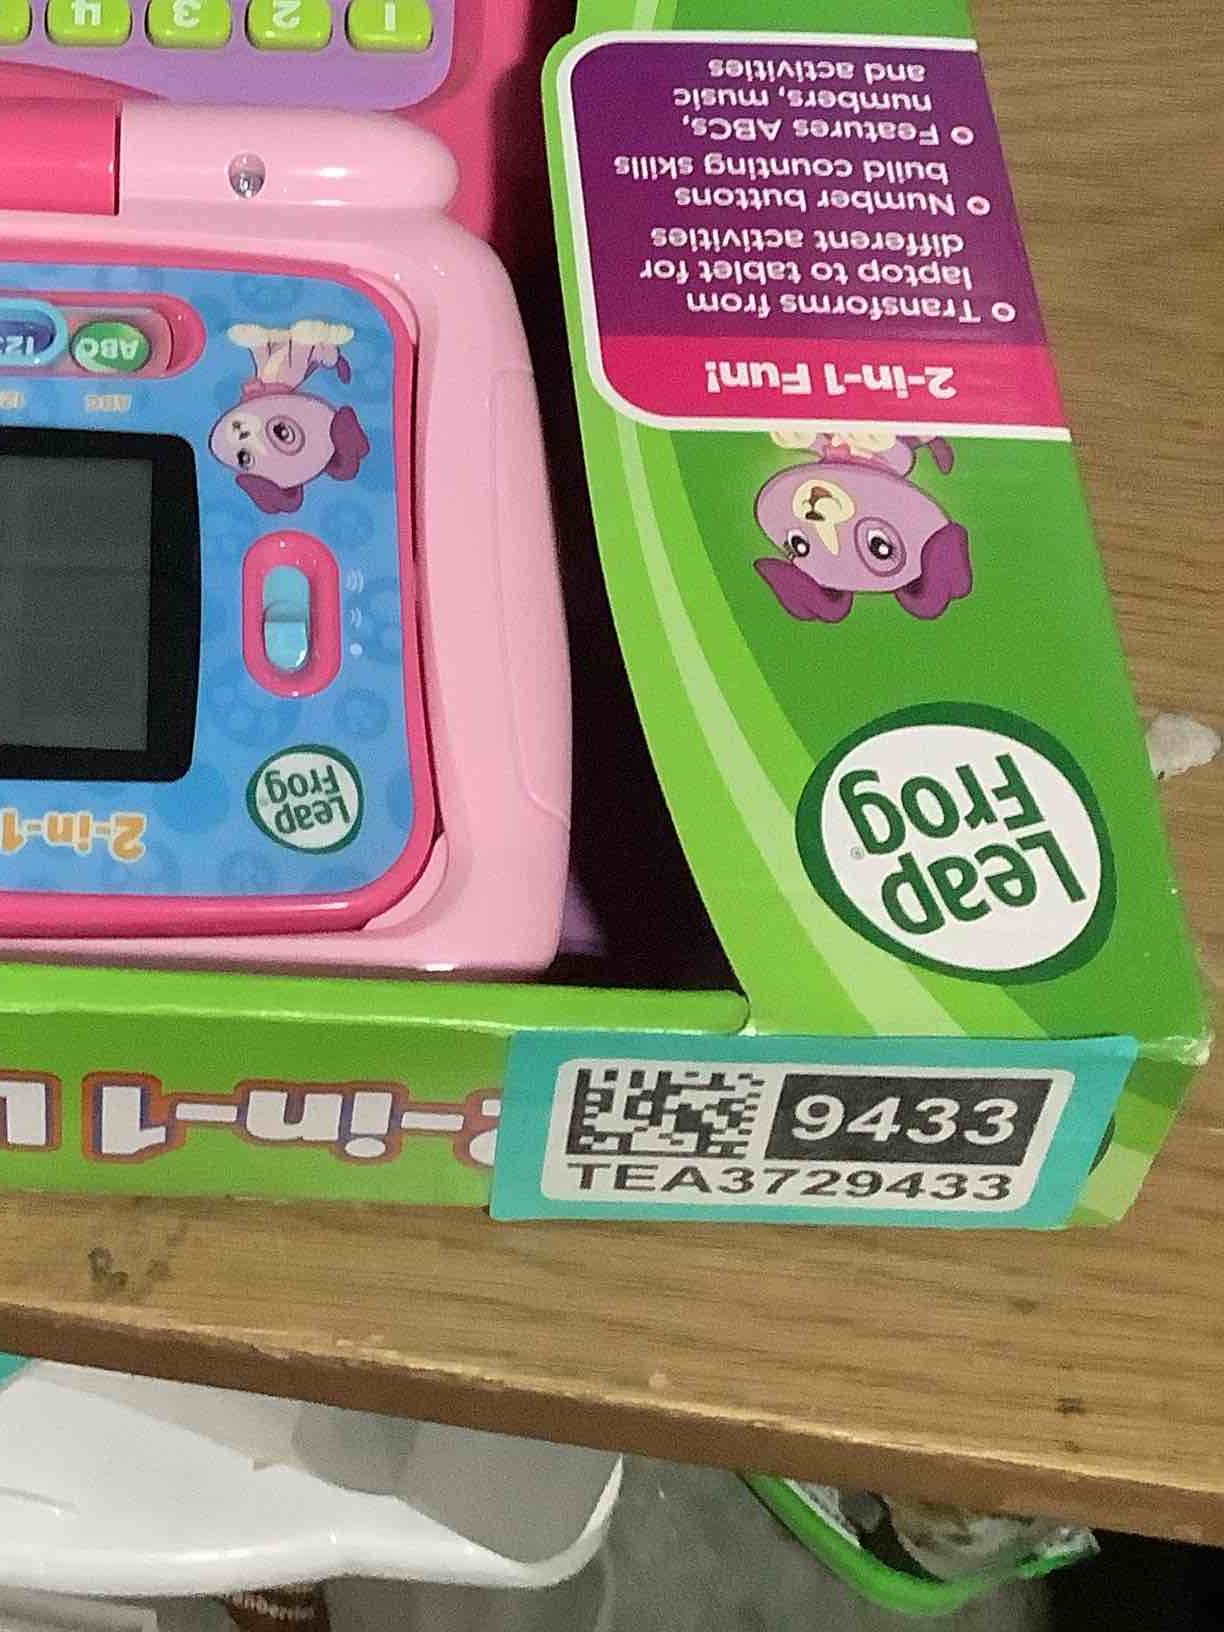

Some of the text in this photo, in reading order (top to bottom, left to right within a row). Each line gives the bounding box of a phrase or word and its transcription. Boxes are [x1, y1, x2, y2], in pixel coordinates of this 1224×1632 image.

[384, 0, 397, 31] 1
[708, 58, 925, 85] and activities
[673, 86, 932, 114] numbers, music
[681, 114, 939, 145] Features ABCs,
[613, 152, 949, 185] build counting skills
[675, 187, 955, 216] Number buttons
[651, 227, 964, 257] different activities
[639, 259, 972, 290] laptop to tablet for
[687, 292, 979, 324] Transforms from
[705, 361, 957, 399] 2-in-1 Fun!
[264, 765, 339, 803] Frog
[275, 796, 350, 834] Leap
[838, 753, 1044, 855] Frog
[0, 808, 146, 859] 2-in-1
[881, 830, 1086, 935] Leap
[791, 1097, 1020, 1146] 9433
[567, 1163, 1012, 1200] TEA3729433
